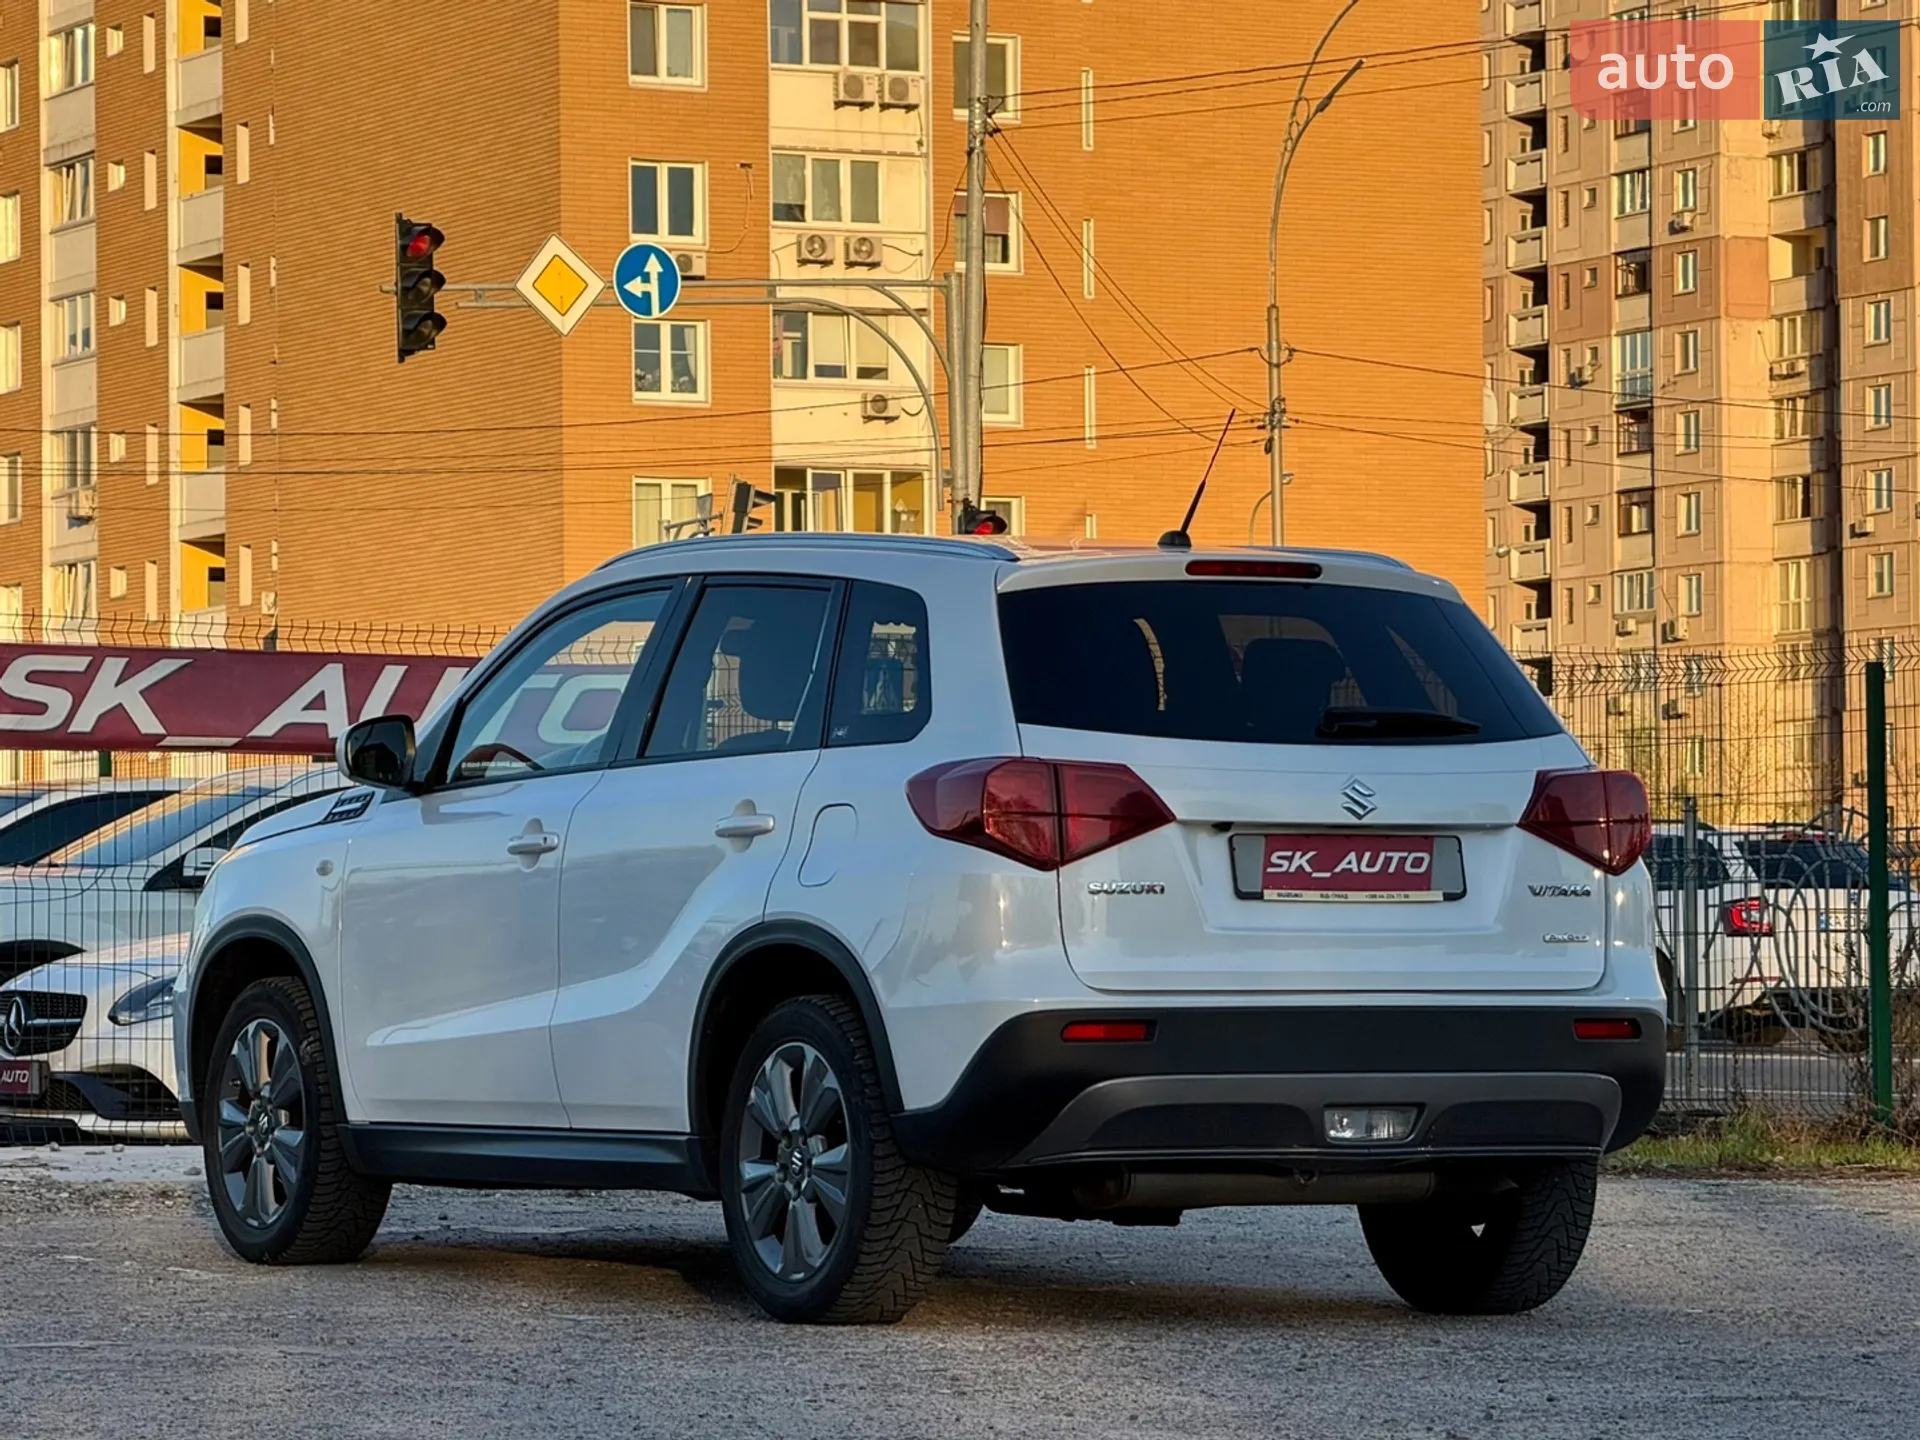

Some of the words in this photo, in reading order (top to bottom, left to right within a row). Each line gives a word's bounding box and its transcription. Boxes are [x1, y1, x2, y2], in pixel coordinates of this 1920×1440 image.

[1266, 851, 1431, 878] SK_AUTO
[1087, 881, 1165, 895] SUZUKI
[1527, 885, 1591, 897] VITARA
